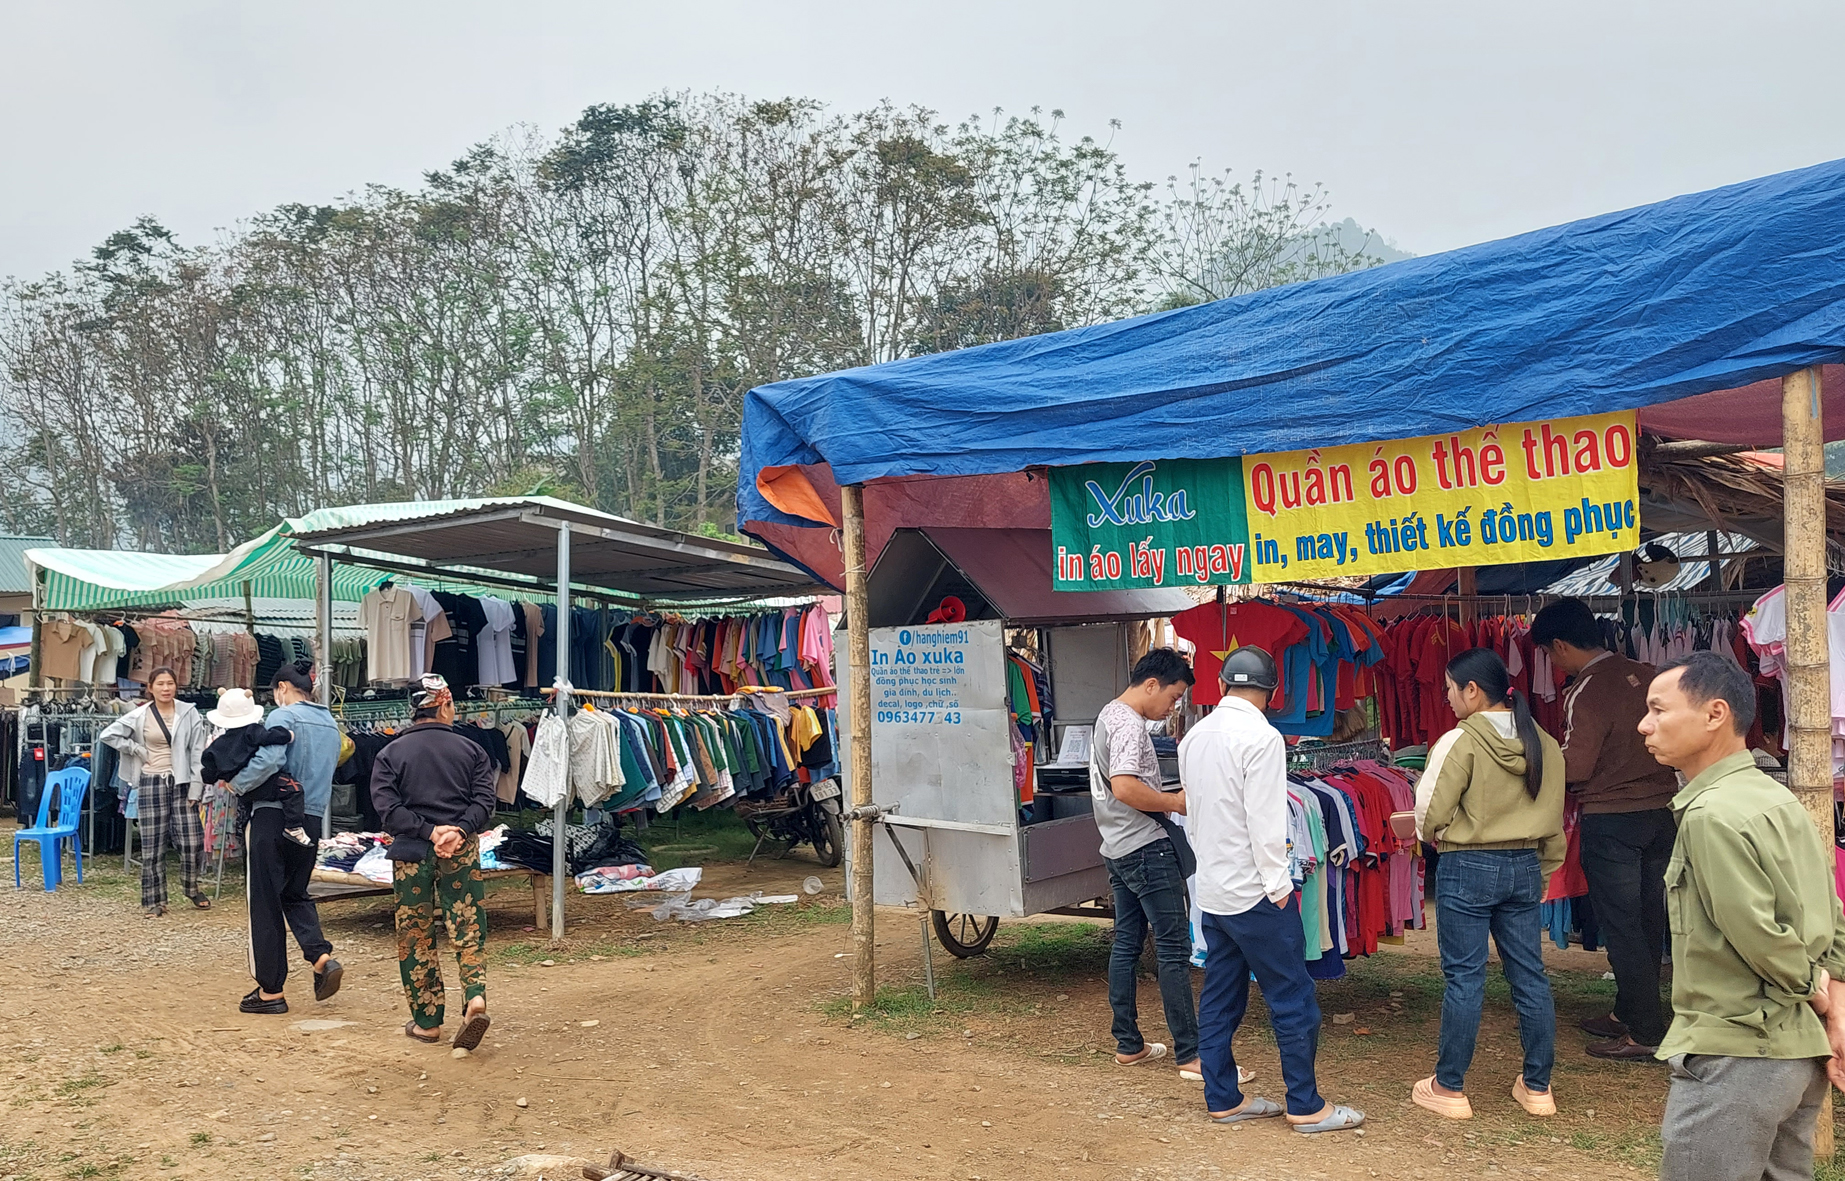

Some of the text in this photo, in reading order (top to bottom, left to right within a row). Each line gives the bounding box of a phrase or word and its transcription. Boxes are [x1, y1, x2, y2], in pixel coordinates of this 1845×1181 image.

[1251, 449, 1354, 518] Quần
[1368, 446, 1417, 500] áo
[1522, 423, 1631, 481] thao
[1085, 460, 1196, 528] Xuka
[1255, 497, 1635, 569] in, may, thiết kế đồng phục
[1058, 536, 1245, 585] in áo lấy ngay
[871, 650, 889, 665] In
[922, 647, 964, 664] xuka
[914, 667, 928, 675] thao
[898, 676, 919, 687] phục
[921, 677, 936, 687] học
[939, 677, 957, 685] sinh
[883, 689, 897, 698] gia
[922, 688, 933, 697] du
[905, 700, 923, 709] logo
